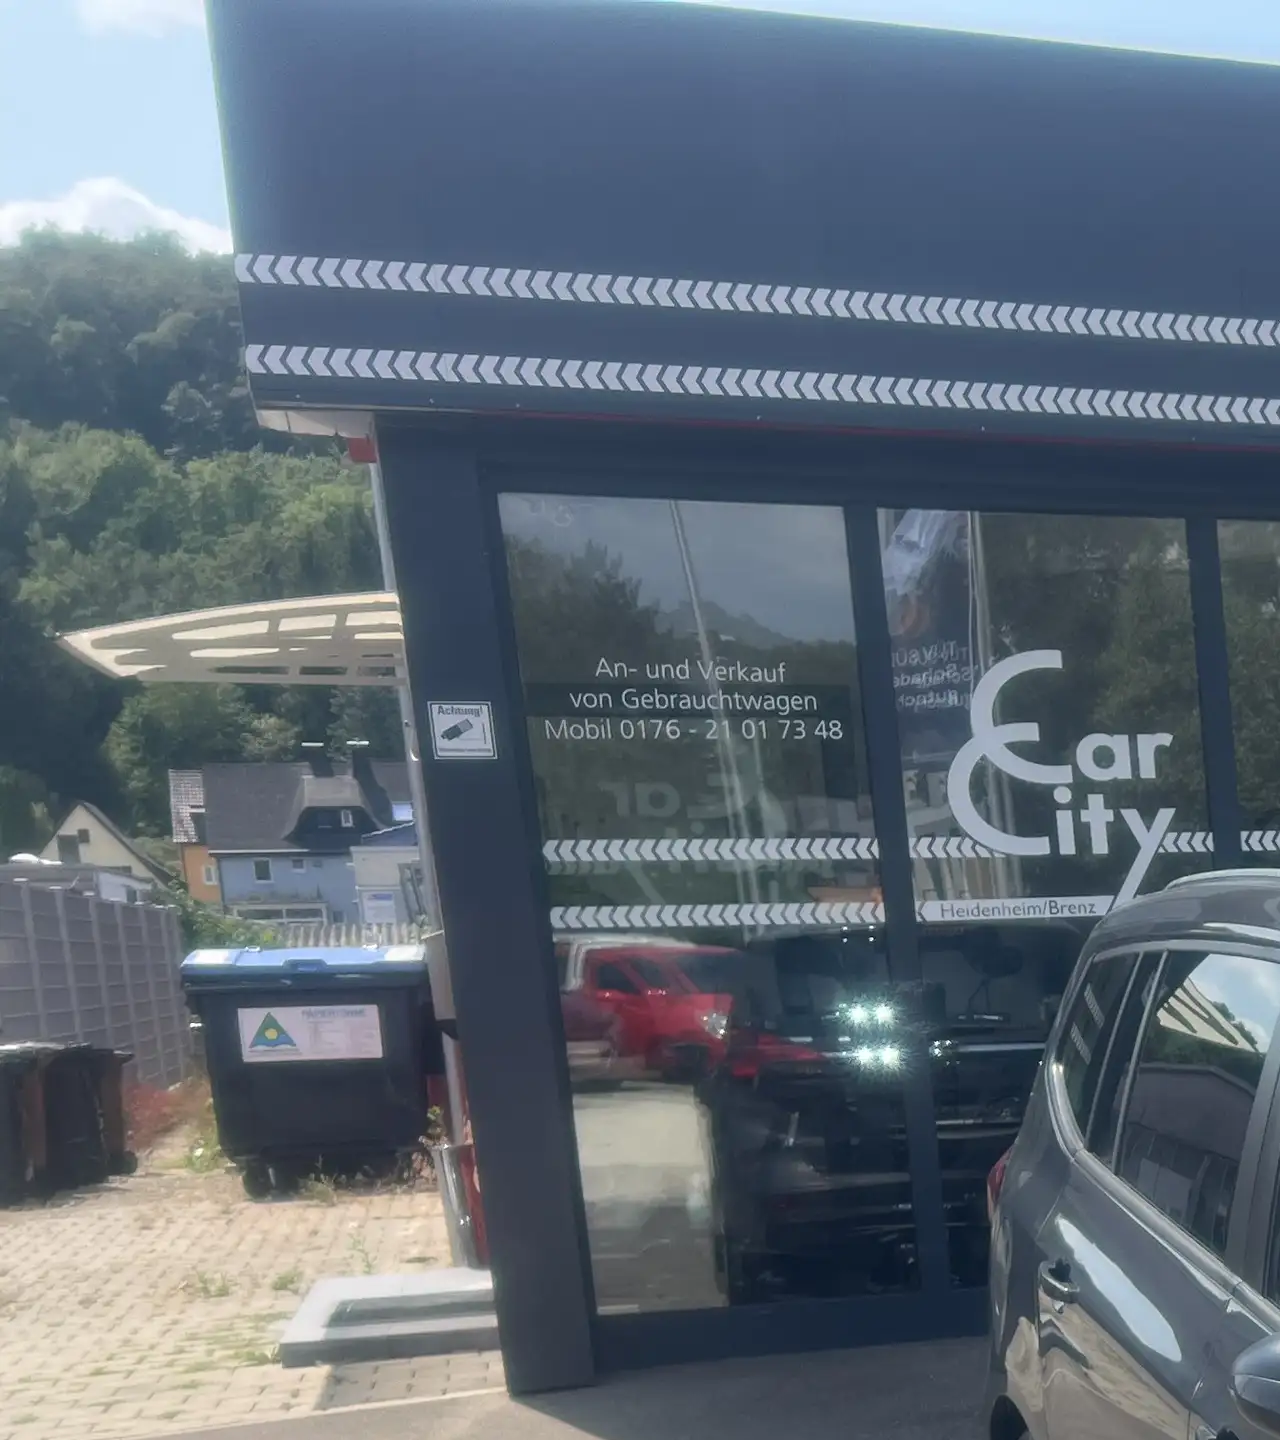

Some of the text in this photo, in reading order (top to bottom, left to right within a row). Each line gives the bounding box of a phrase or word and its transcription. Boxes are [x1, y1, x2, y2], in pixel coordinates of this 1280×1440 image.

[595, 657, 786, 683] An- und Verkauf
[570, 688, 818, 716] von Gebrauchtwagen
[545, 718, 613, 740] Mobil
[620, 719, 682, 741] 0176
[705, 719, 731, 741] 21
[741, 719, 768, 741] 01
[778, 719, 806, 741] 73
[814, 719, 844, 741] 48
[940, 900, 1098, 920] Heidenheim/Brenz
